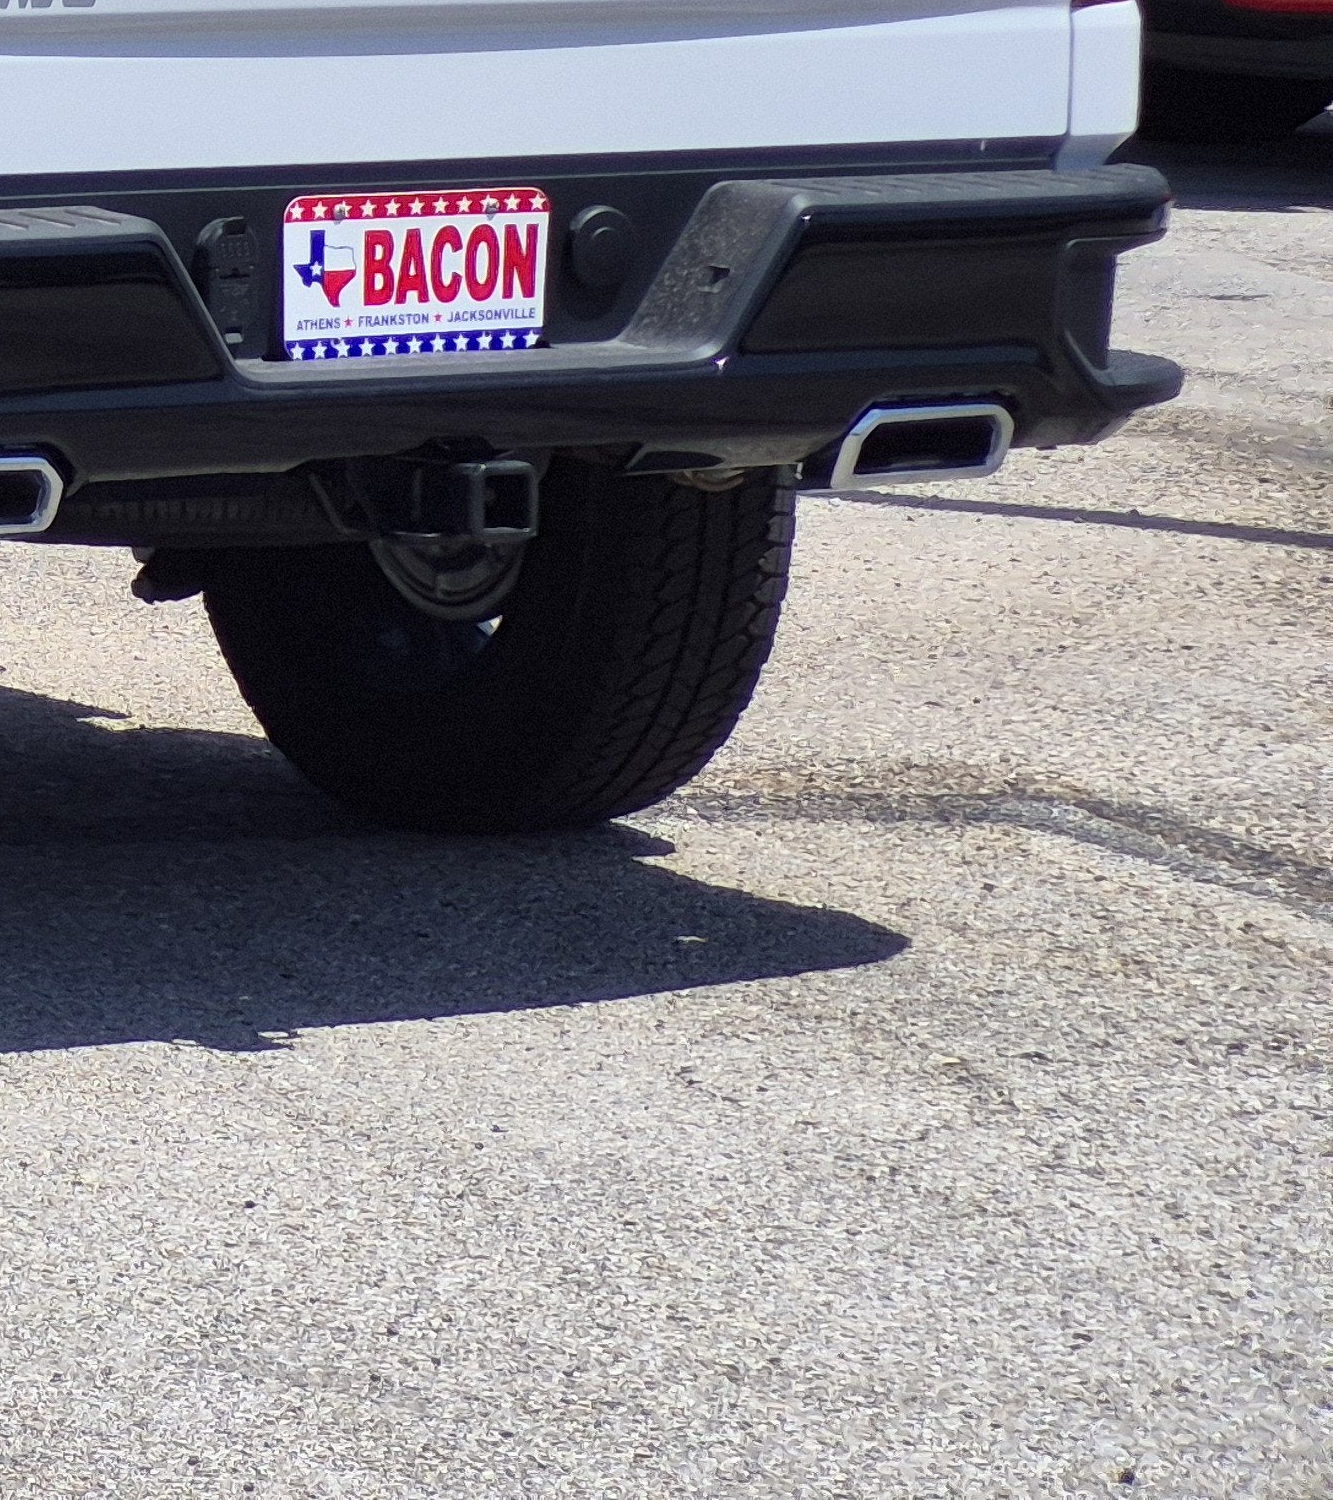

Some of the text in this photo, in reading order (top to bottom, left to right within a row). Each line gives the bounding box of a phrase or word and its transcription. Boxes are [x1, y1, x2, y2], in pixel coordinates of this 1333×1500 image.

[363, 223, 540, 307] BACON
[296, 307, 536, 331] ATHENS FRANKSTON JACKSONVILLE
